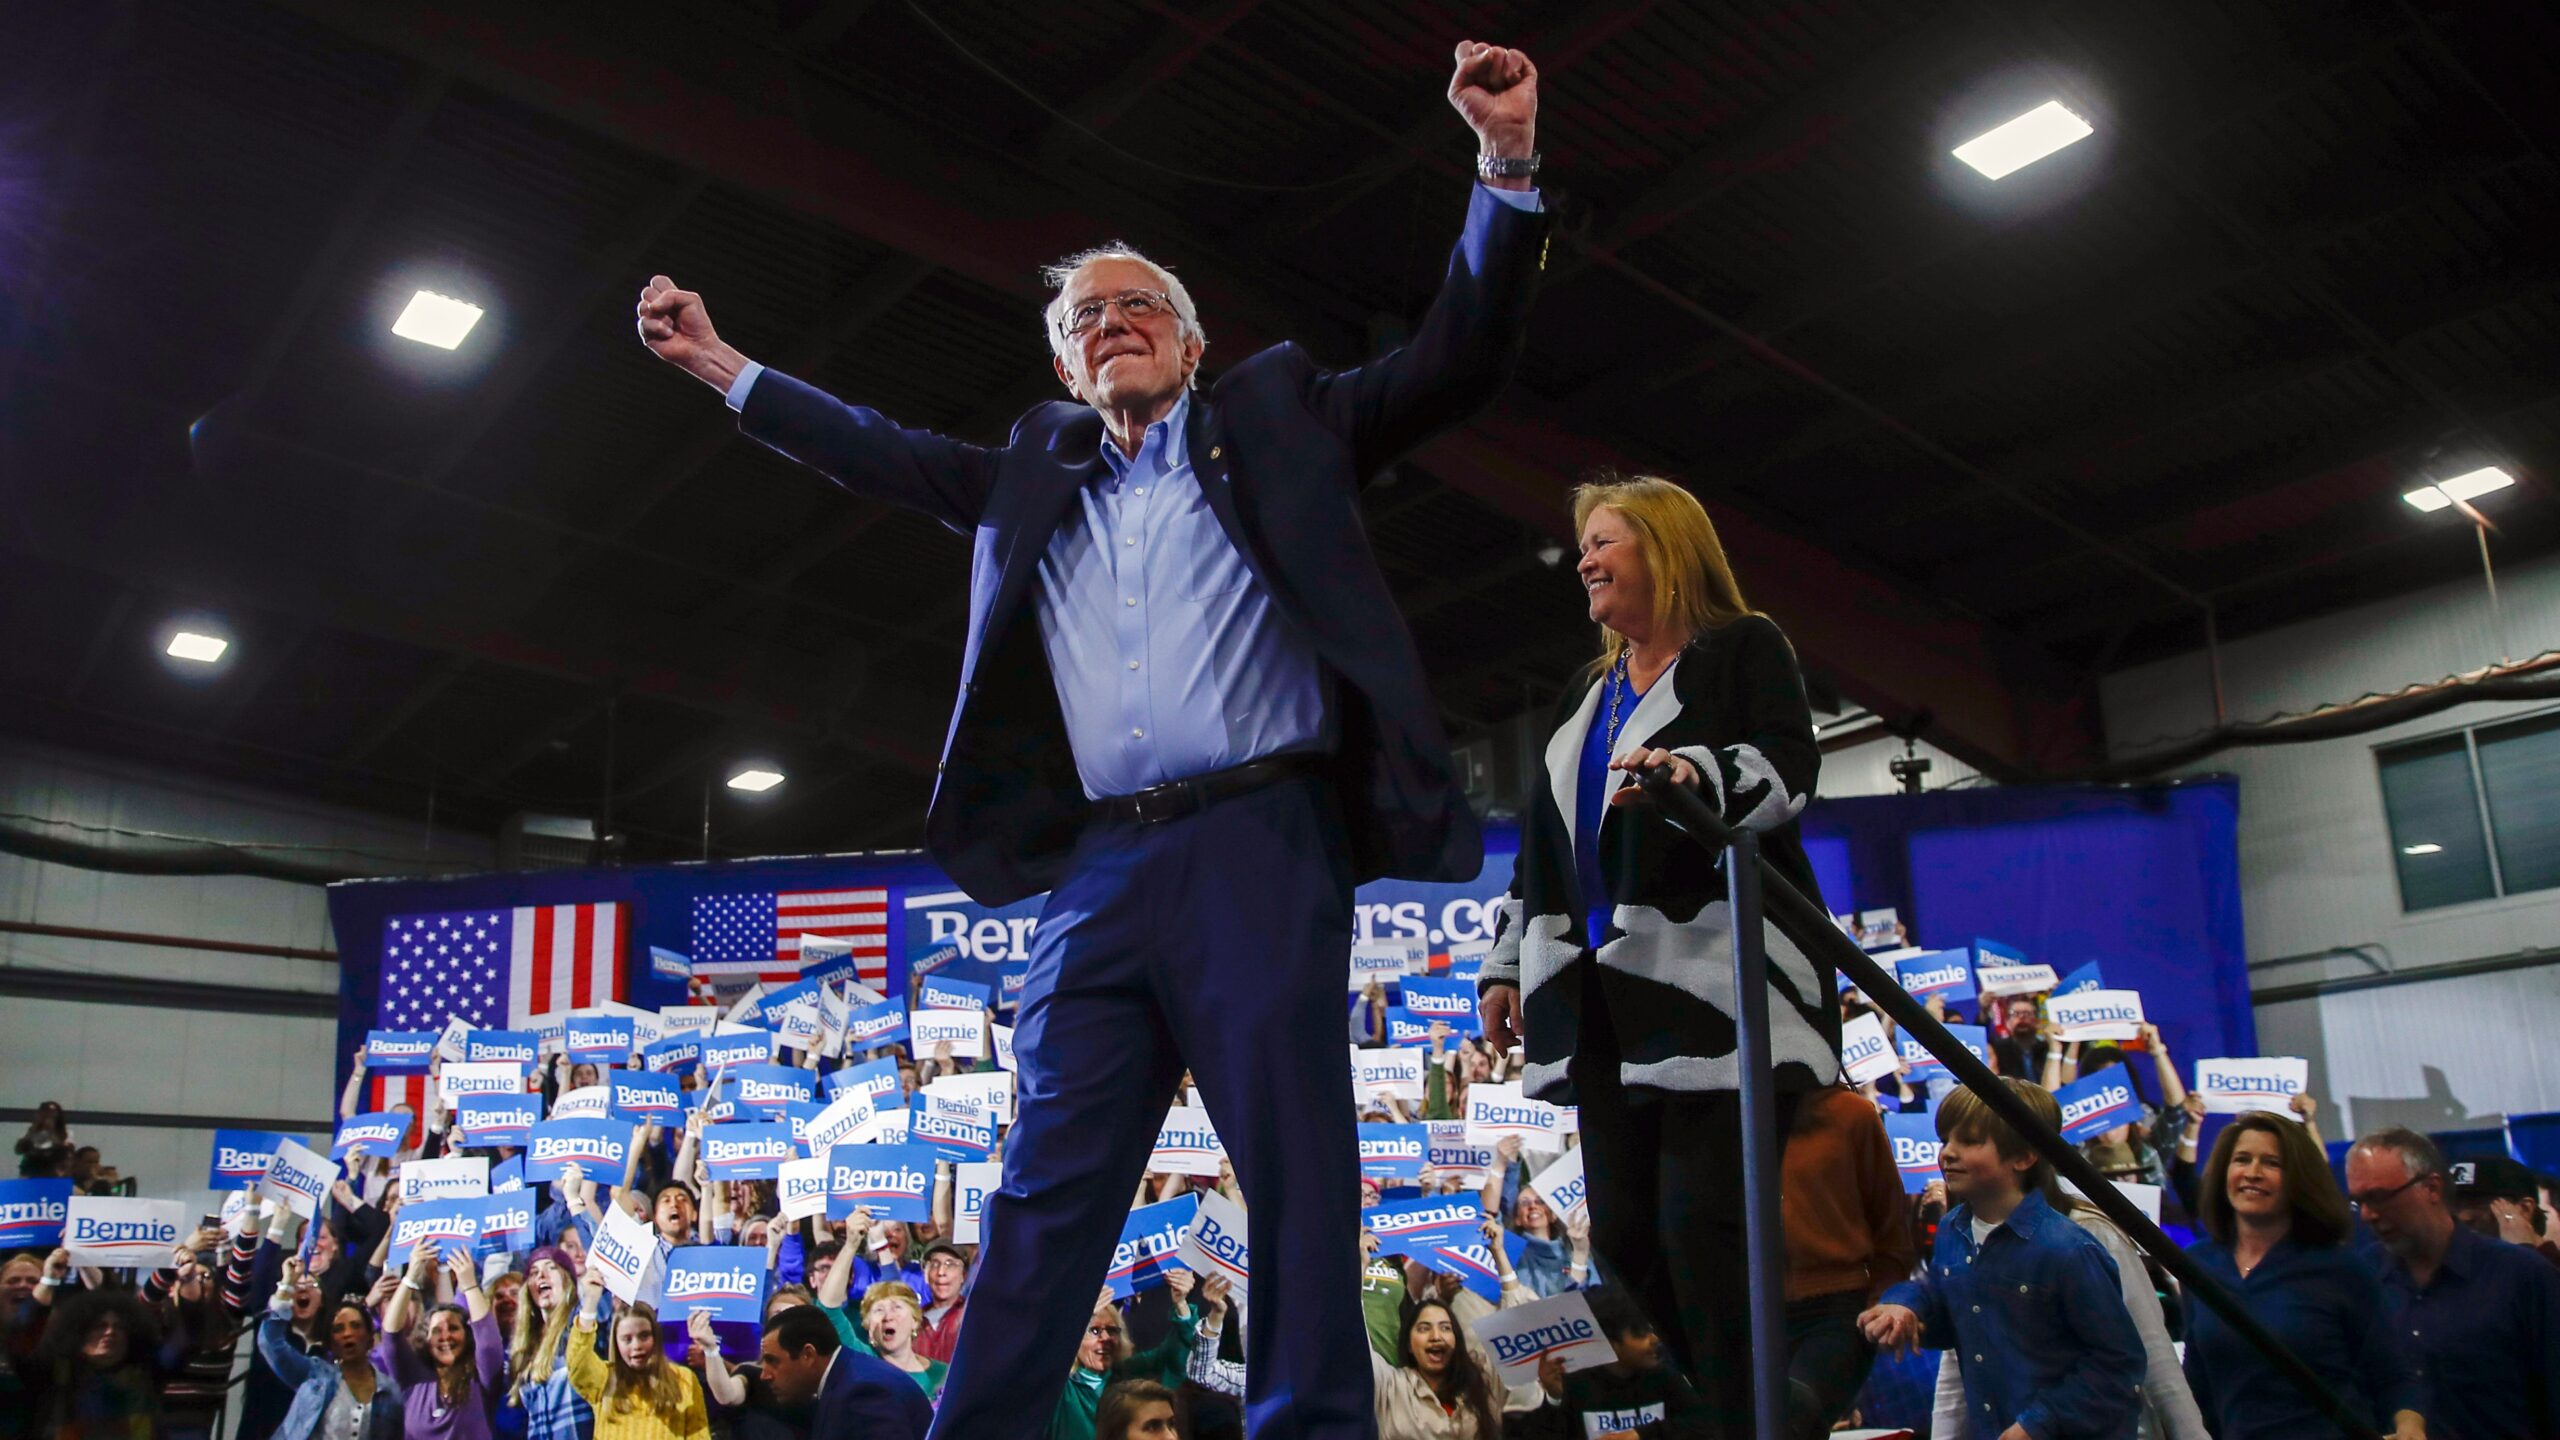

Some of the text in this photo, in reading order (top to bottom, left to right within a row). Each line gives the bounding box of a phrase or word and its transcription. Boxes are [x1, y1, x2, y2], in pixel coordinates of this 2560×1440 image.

[1351, 896, 1505, 947] rs.c
[913, 943, 957, 974] Bernie
[1353, 953, 1405, 970] Bernie
[1902, 964, 1967, 993] Bernie
[926, 988, 983, 1010] Bernie
[1404, 990, 1472, 1013] Bernie
[664, 1014, 711, 1028] Bernie
[853, 1009, 904, 1035] Bernie
[2056, 1004, 2136, 1023] Bernie
[568, 1028, 630, 1047] Bernie
[916, 1023, 978, 1041] Bernie
[368, 1039, 432, 1054] Bernie
[470, 1043, 534, 1060] Bernie
[647, 1043, 700, 1071] Bernie
[705, 1043, 768, 1065] Bernie
[446, 1075, 514, 1091] Bernie
[740, 1078, 811, 1103] Bernie
[2206, 1072, 2299, 1094] Bernie
[615, 1084, 679, 1107] Bernie
[936, 1097, 979, 1117] Bernie
[461, 1107, 536, 1127] Bernie
[1473, 1101, 1555, 1128] Bernie
[338, 1123, 399, 1143] Bernie
[813, 1105, 869, 1151] Bernie
[913, 1110, 991, 1147] Bernie
[1431, 1122, 1466, 1135] Bern
[532, 1135, 624, 1161] Bernie
[706, 1137, 787, 1160] Bernie
[270, 1157, 325, 1197] Bernie
[831, 1164, 926, 1194] Bernie
[1550, 1174, 1585, 1210] Be
[395, 1213, 477, 1243] Bernie
[1370, 1203, 1477, 1229] Bernie
[74, 1218, 176, 1241] Bernie
[595, 1222, 640, 1275] Bernie
[1109, 1222, 1190, 1269] ernie
[667, 1266, 757, 1293] Bernie
[1490, 1316, 1594, 1360] Bernie
